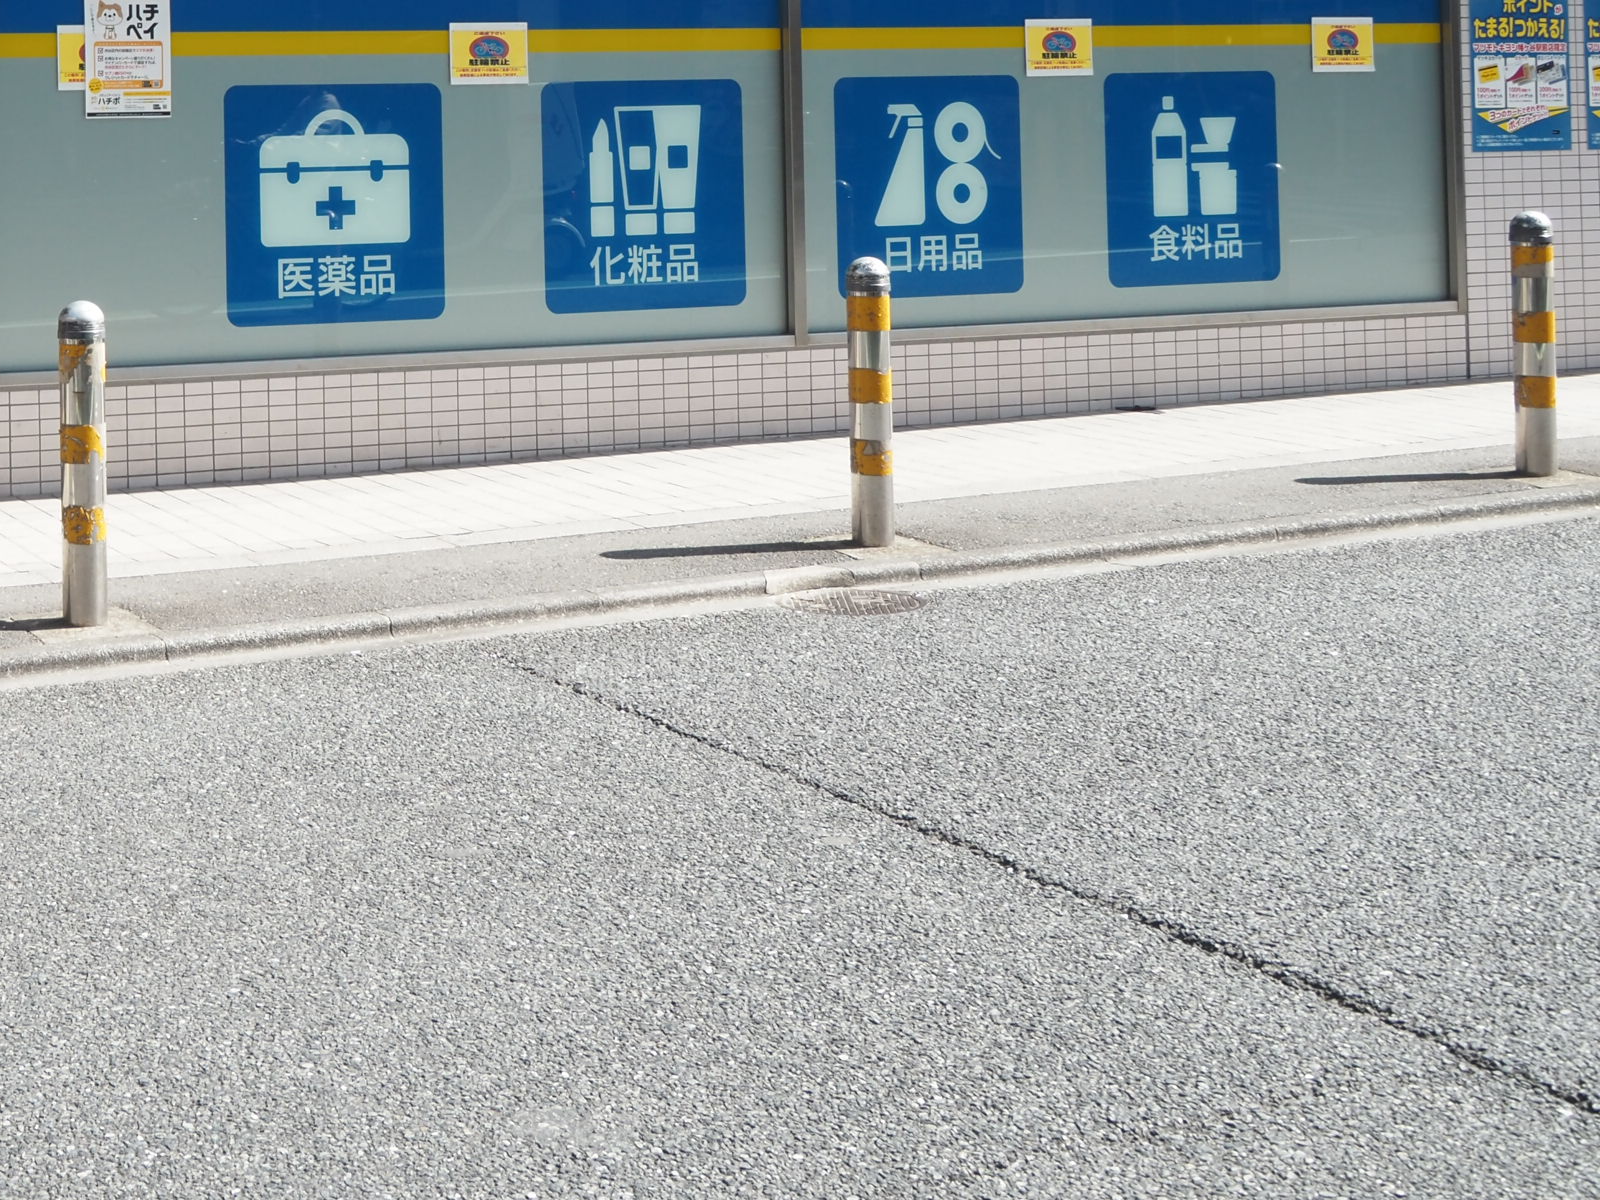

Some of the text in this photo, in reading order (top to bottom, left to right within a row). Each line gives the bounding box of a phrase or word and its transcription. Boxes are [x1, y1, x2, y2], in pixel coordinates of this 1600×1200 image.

[126, 4, 159, 21] ハチ
[126, 22, 159, 39] ペイ
[884, 233, 983, 273] 日用品
[1149, 223, 1243, 264] 食料品
[276, 255, 396, 299] 医薬品
[589, 244, 699, 286] 化粧品
